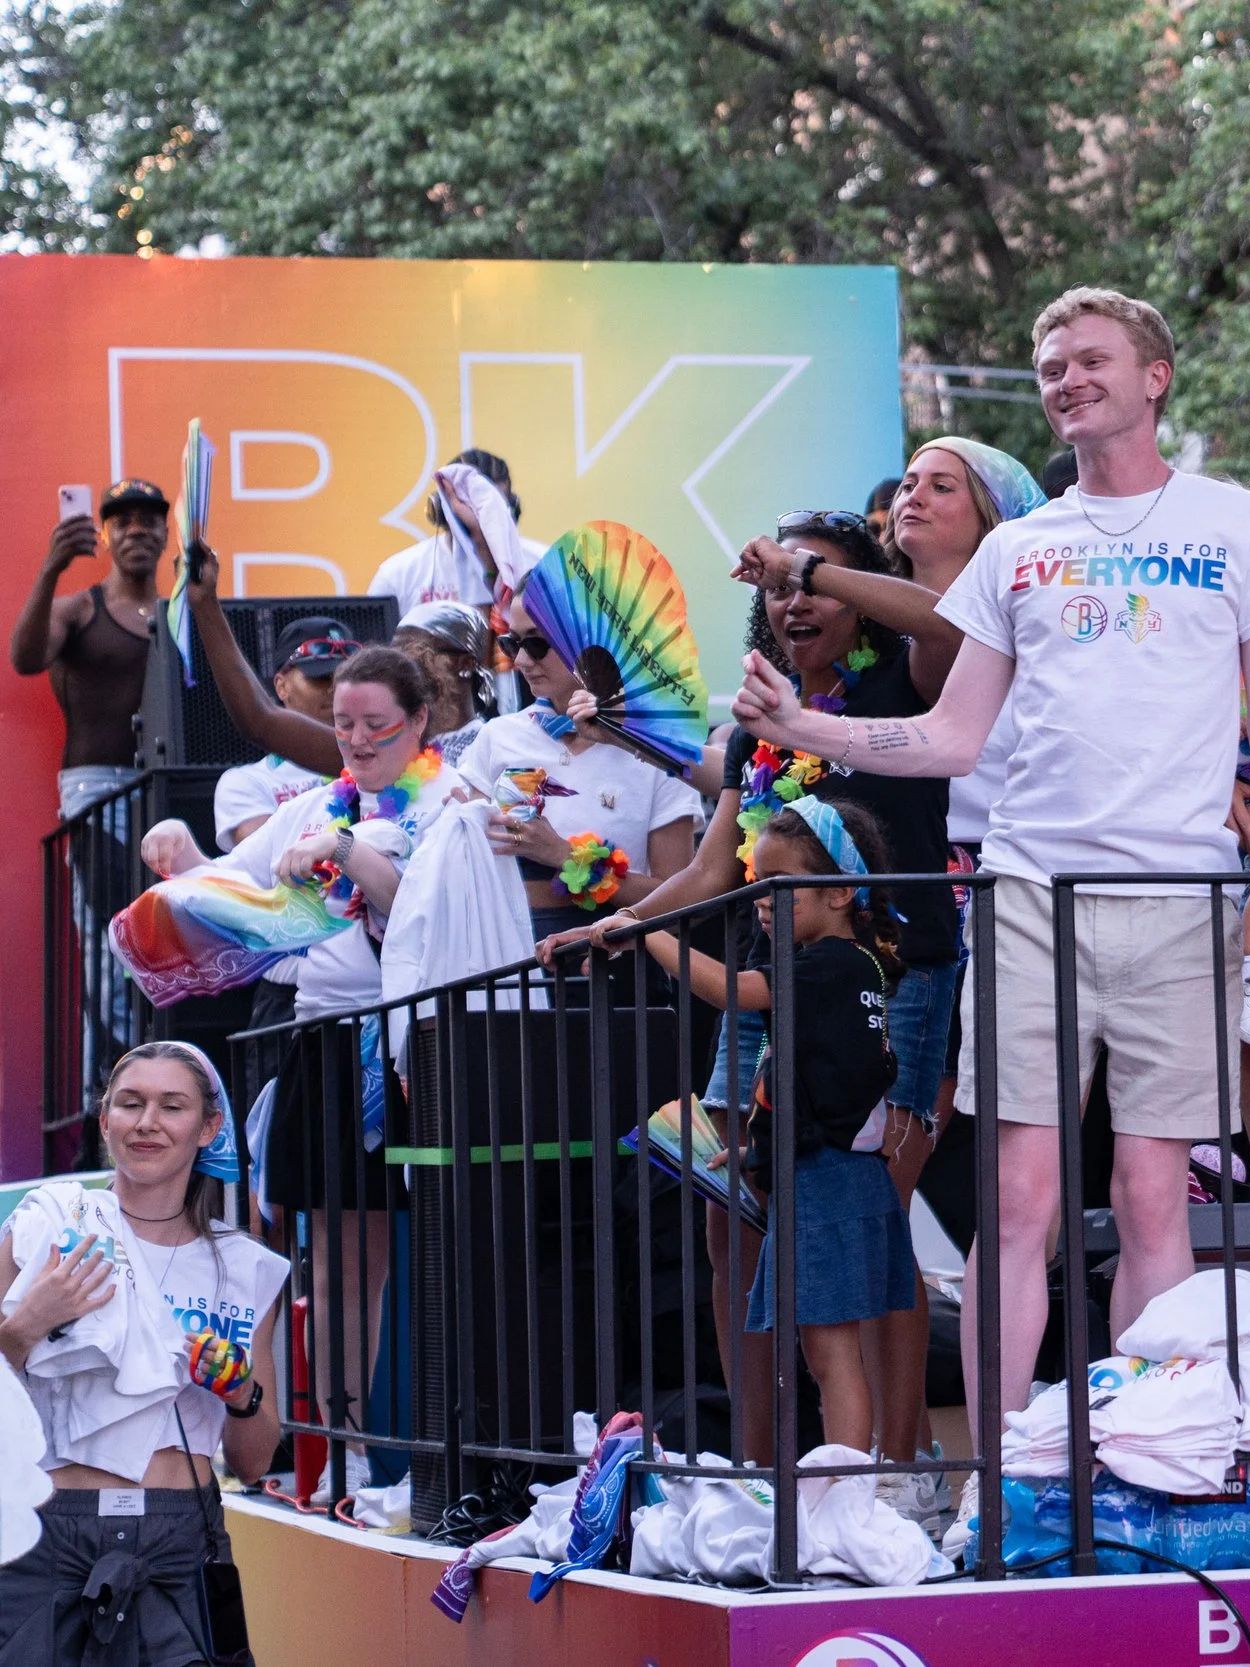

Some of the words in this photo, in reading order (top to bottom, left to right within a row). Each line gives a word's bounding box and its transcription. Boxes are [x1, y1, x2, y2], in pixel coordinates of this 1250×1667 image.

[108, 347, 812, 705] BK
[1016, 542, 1133, 566] BROOKLYN
[1148, 542, 1168, 555] IS
[1184, 544, 1227, 560] FOR
[1010, 556, 1226, 592] EVERYONE
[568, 552, 597, 593] NEW
[596, 588, 631, 640] YORK
[630, 634, 696, 706] LIBERTY
[1078, 603, 1092, 635] B
[188, 1297, 207, 1309] IS
[220, 1301, 255, 1320] FOR
